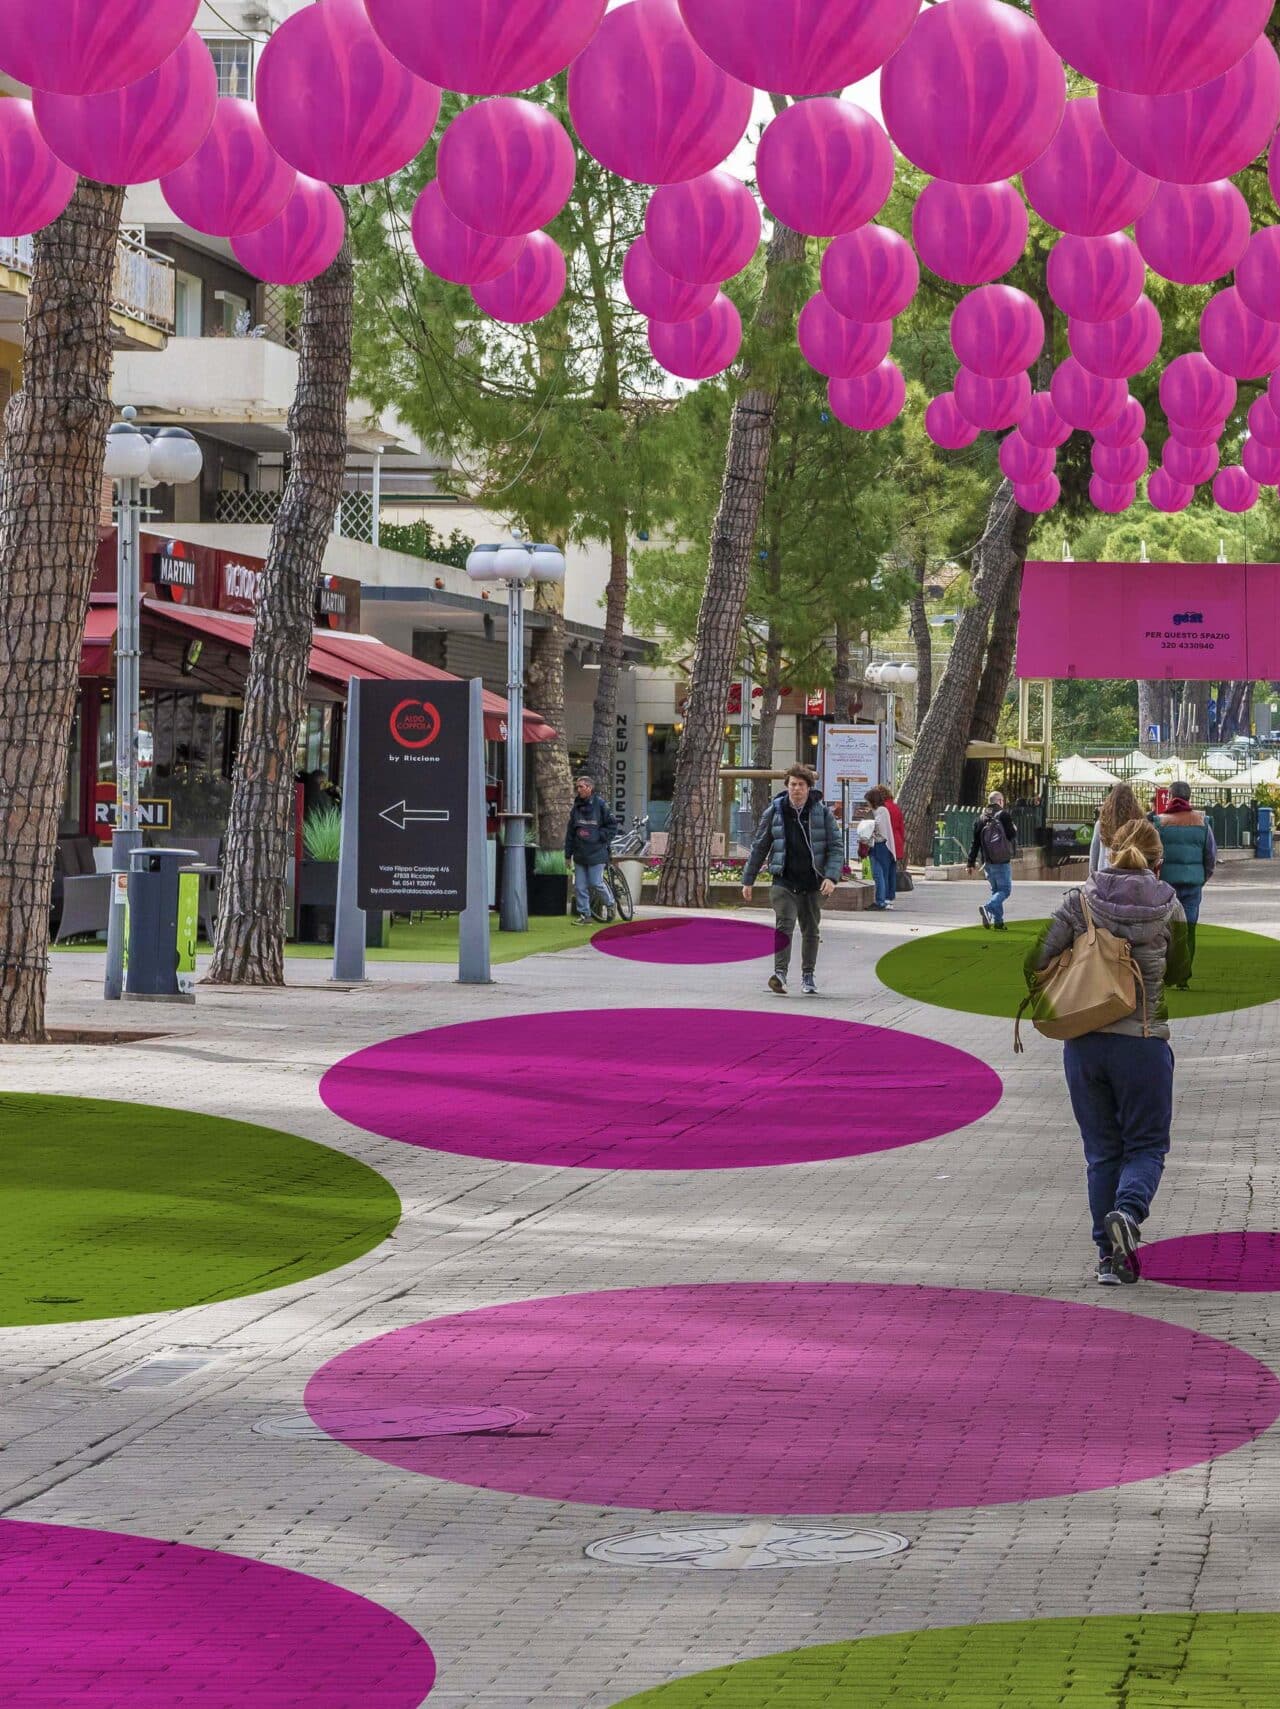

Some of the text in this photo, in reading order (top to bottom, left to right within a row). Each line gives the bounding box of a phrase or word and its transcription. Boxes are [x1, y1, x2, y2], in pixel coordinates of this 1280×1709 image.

[161, 558, 195, 585] MARTINI
[321, 590, 346, 613] MARTINI
[1200, 632, 1230, 640] SPAZIO
[616, 714, 628, 753] NEW
[389, 754, 400, 762] by
[96, 803, 164, 824] RTNI
